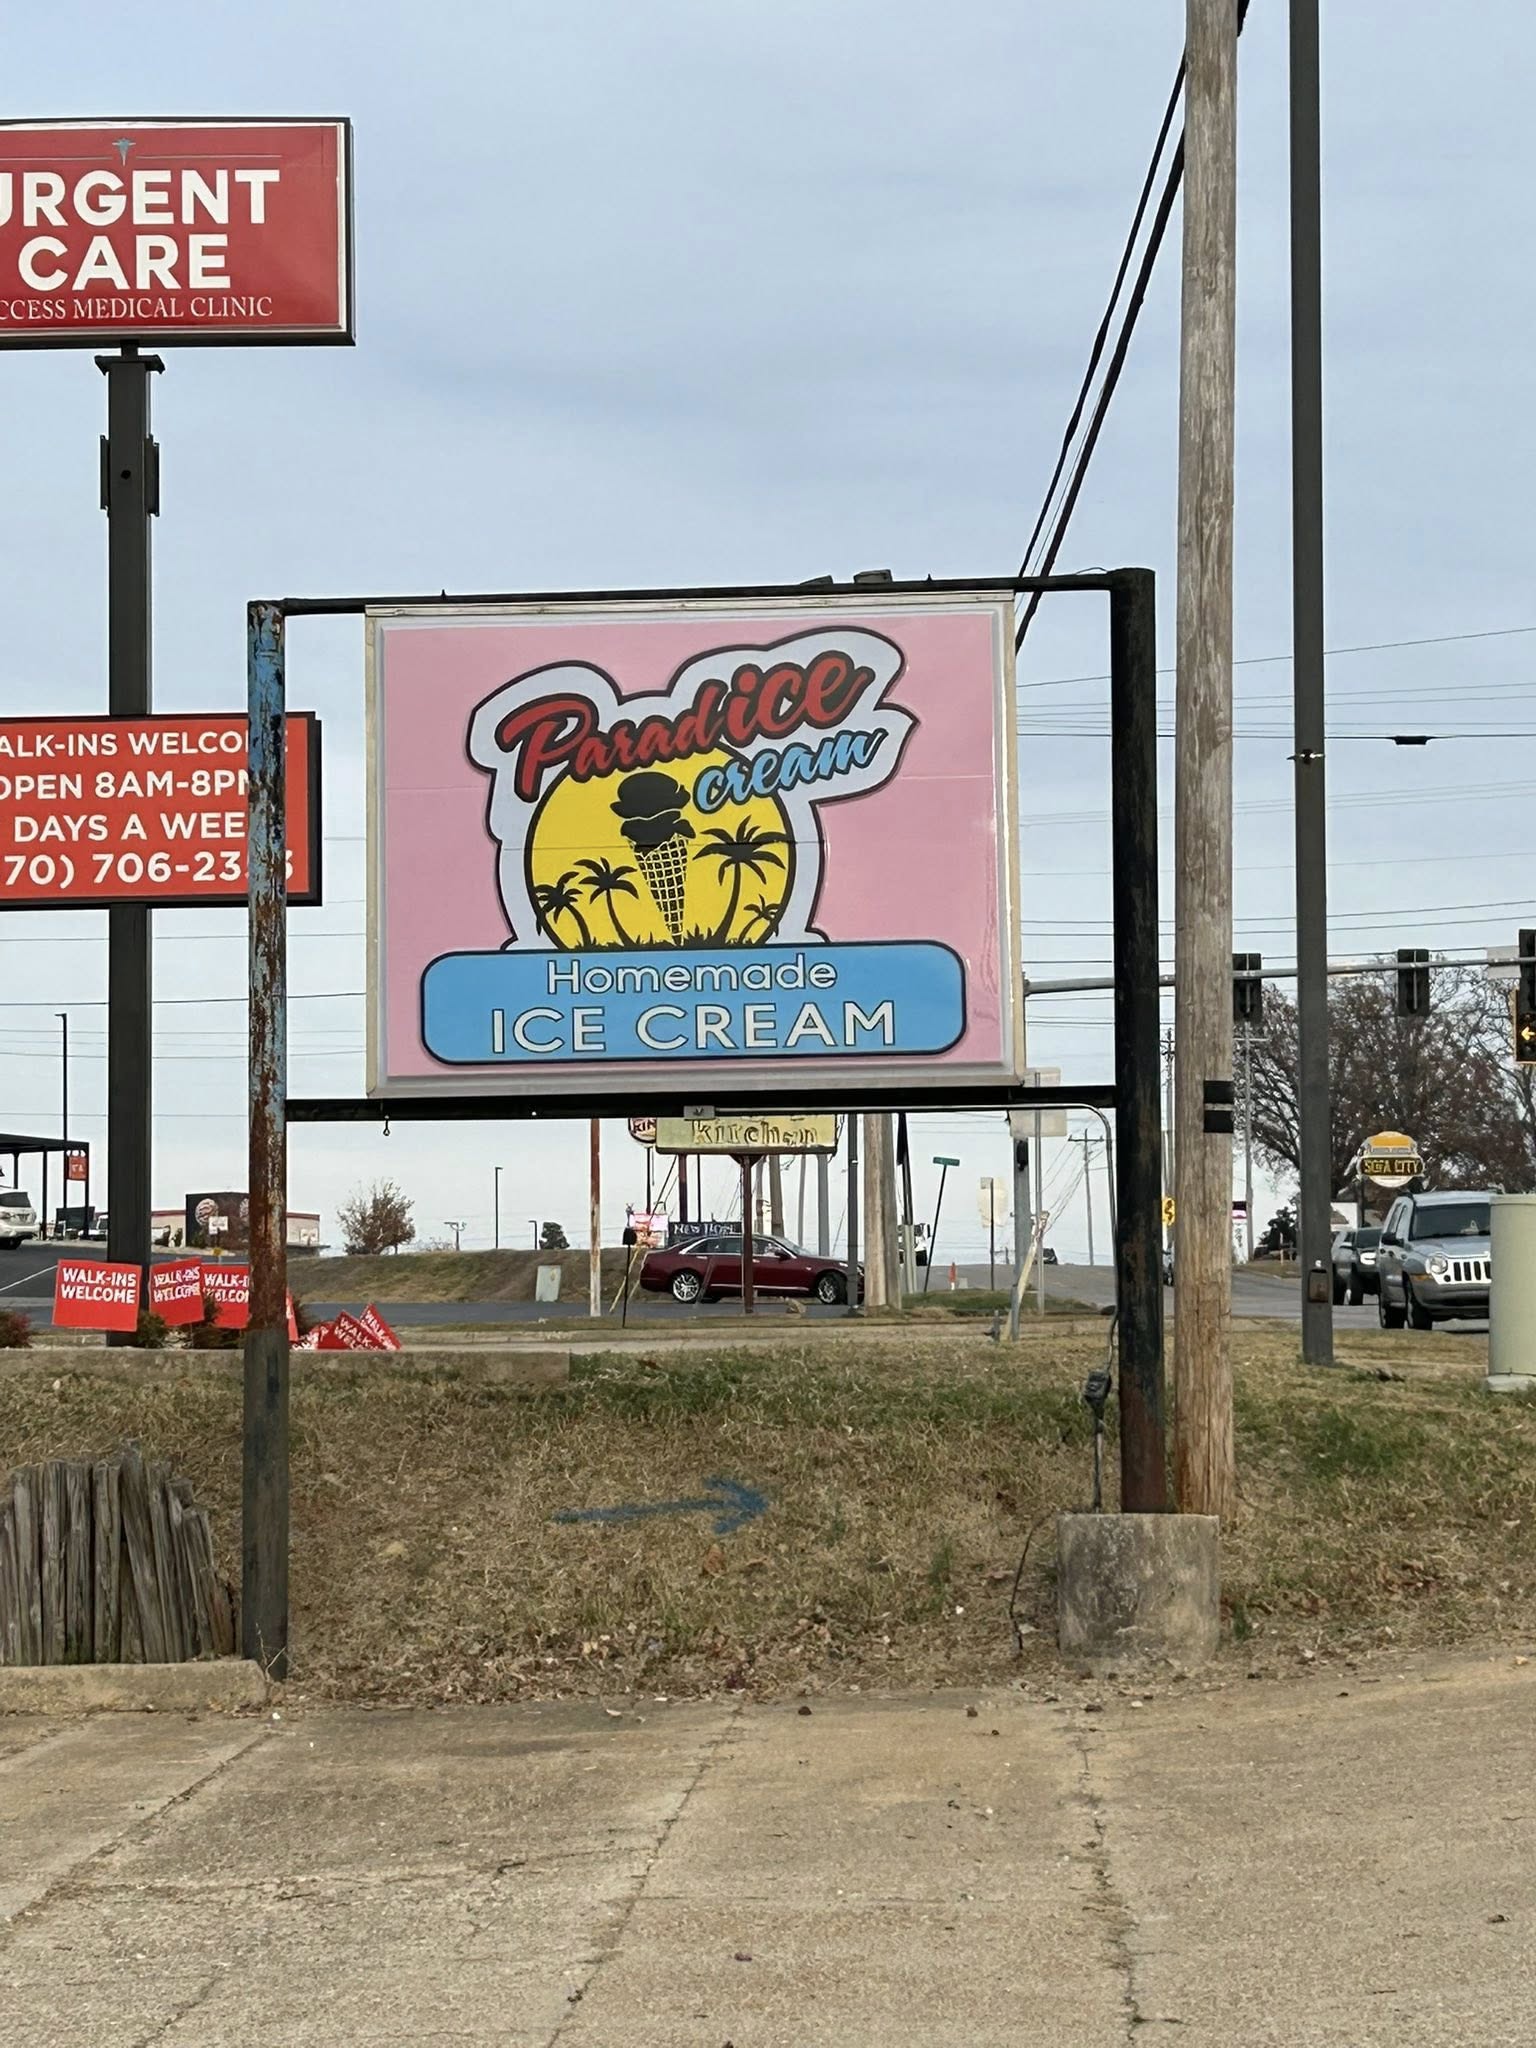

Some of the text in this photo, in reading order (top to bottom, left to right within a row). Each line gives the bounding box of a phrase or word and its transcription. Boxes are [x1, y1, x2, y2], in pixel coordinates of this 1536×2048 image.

[18, 234, 231, 291] CARE
[73, 297, 184, 319] MEDICAL
[190, 296, 273, 317] CLINIC
[128, 731, 288, 755] WELCO
[14, 811, 246, 842] DAYS A WEE
[92, 849, 294, 884] 706-23
[547, 953, 838, 996] Homemade
[490, 1000, 896, 1054] ICE CREAM
[62, 1267, 136, 1287] WALK-INS
[204, 1273, 249, 1287] WALK-I
[60, 1284, 136, 1304] WELCOME
